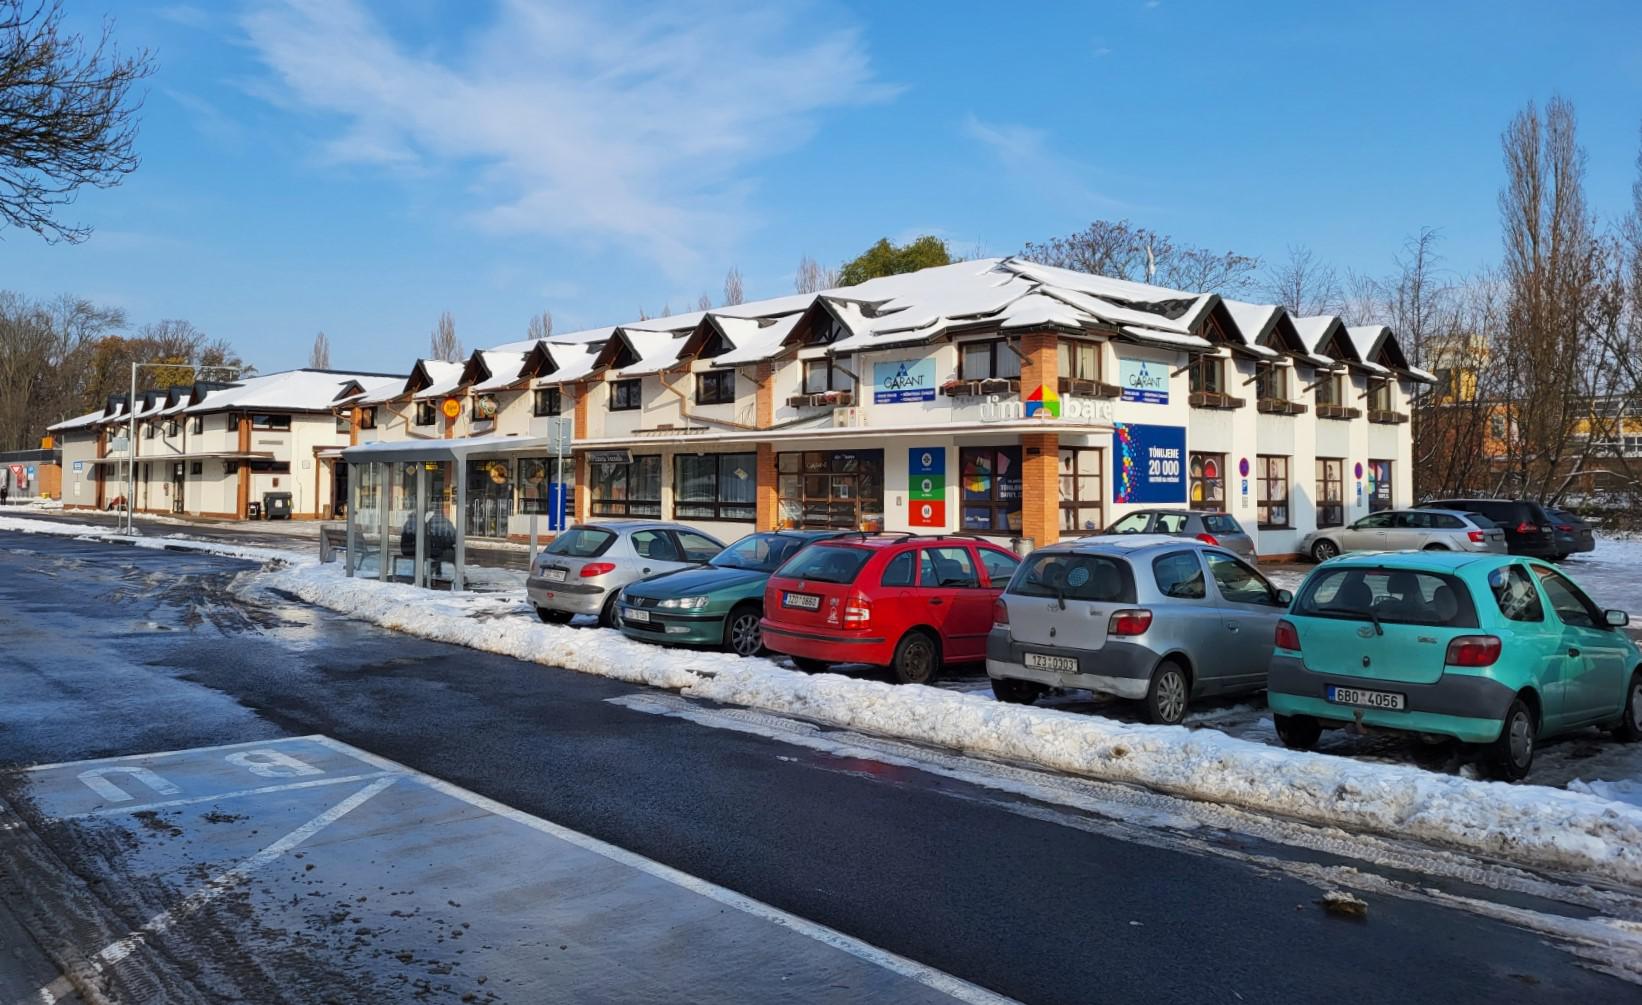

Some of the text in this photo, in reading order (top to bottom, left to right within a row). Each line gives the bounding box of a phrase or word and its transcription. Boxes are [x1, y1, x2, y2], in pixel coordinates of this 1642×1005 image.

[884, 375, 924, 390] GARANT
[1129, 374, 1162, 388] GARANT
[1149, 460, 1179, 475] 20 000
[1032, 655, 1075, 671] 1Z3 0303
[1337, 689, 1398, 708] 6B0 4056
